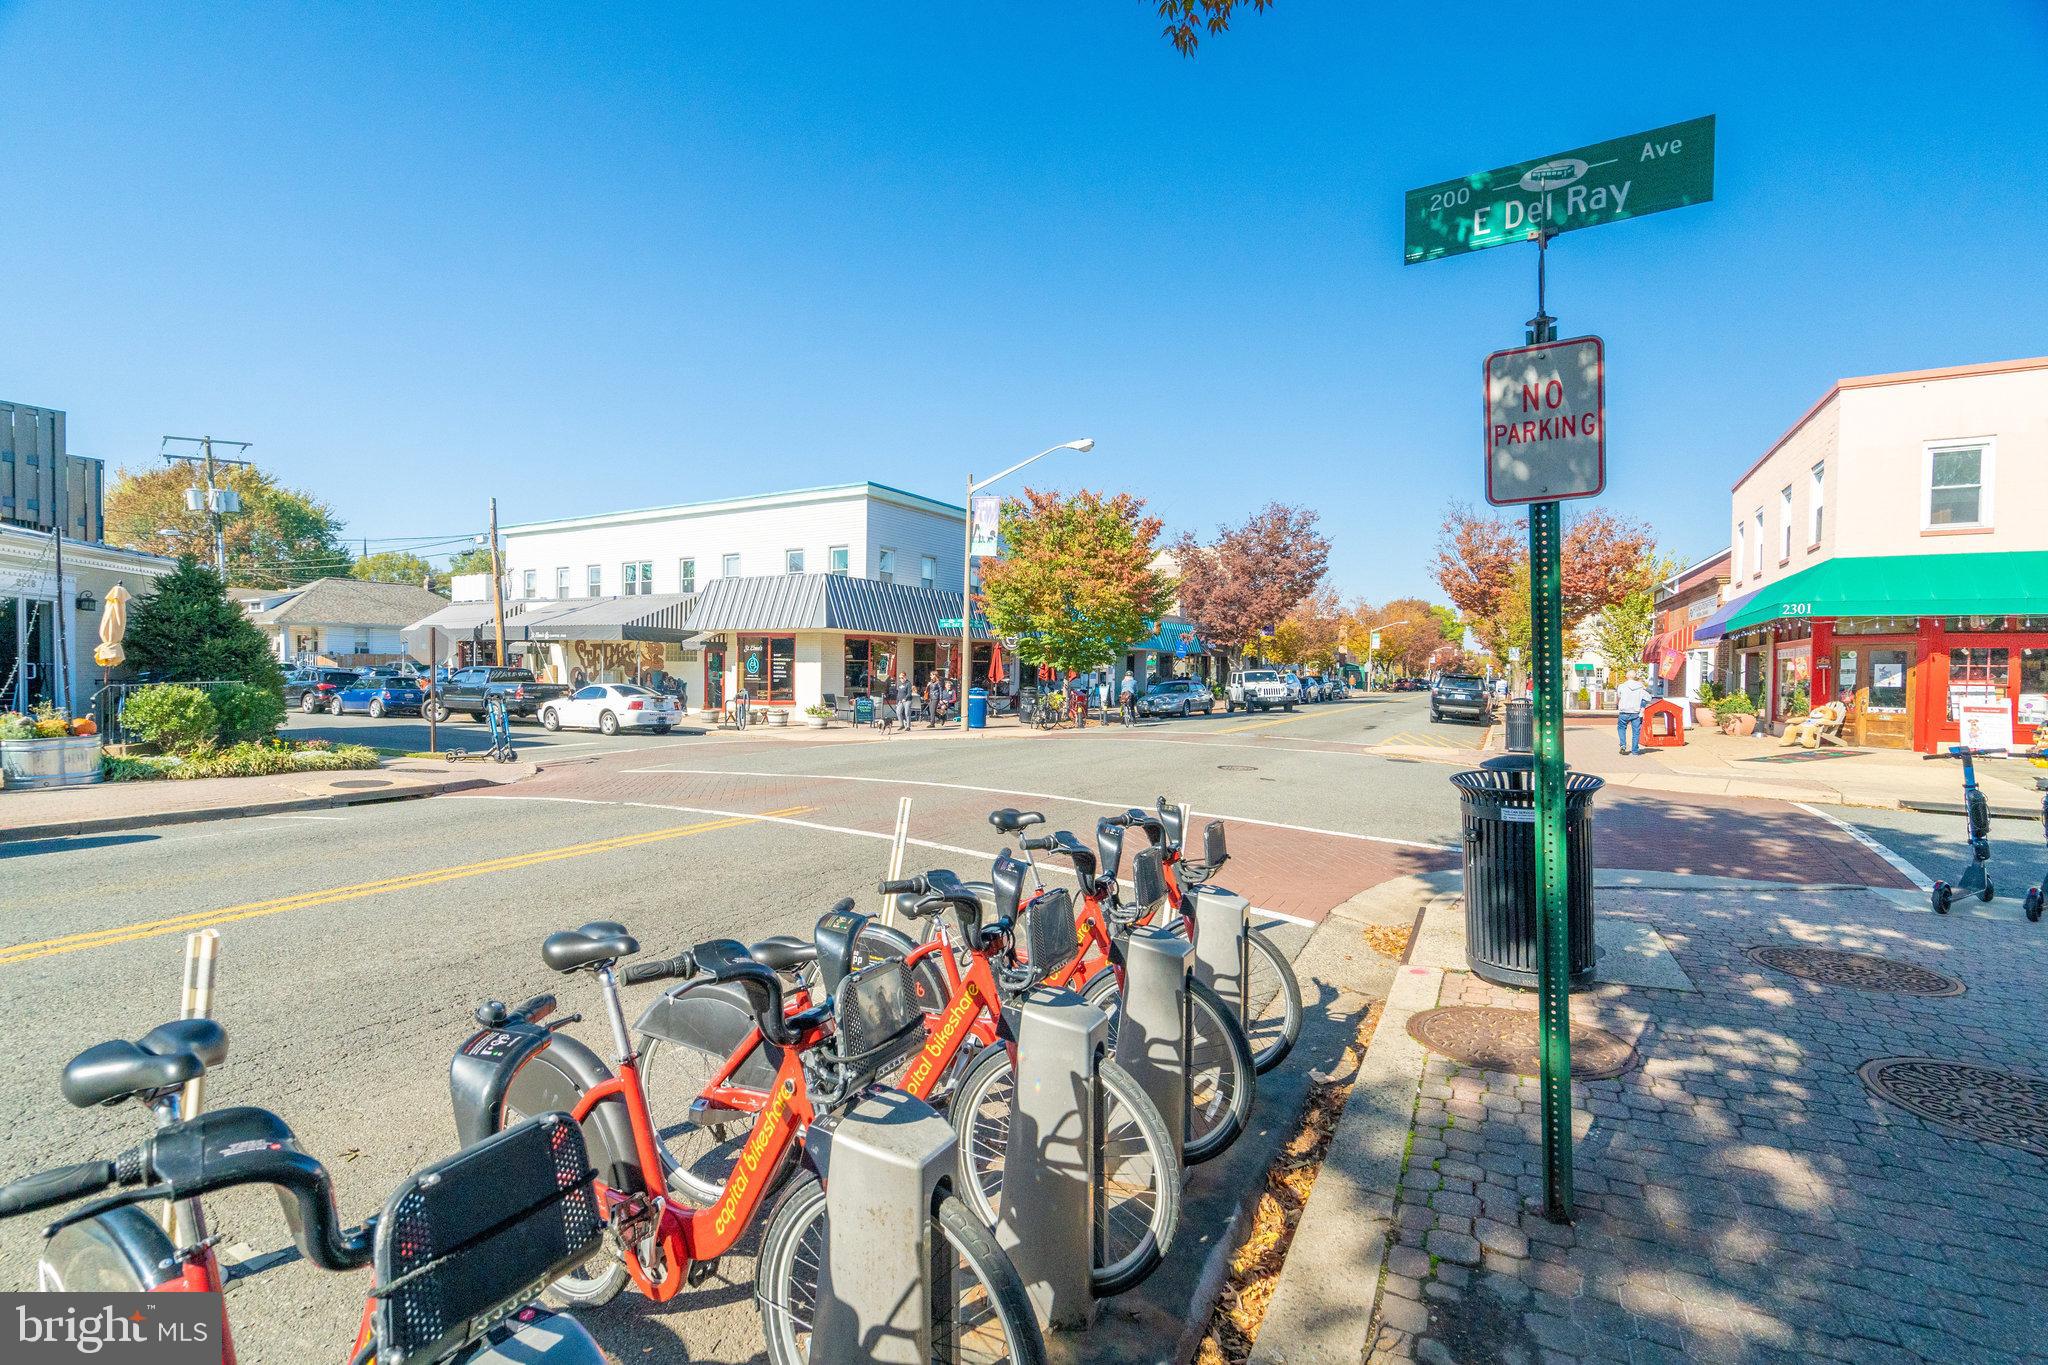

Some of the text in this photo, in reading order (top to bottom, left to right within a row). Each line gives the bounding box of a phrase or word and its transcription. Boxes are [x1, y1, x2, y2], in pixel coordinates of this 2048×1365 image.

[1640, 139, 1683, 163] Ave
[1430, 187, 1470, 212] 200
[1473, 180, 1632, 236] E Del Ray
[1522, 379, 1563, 413] NO
[1494, 412, 1596, 447] PARKING
[1782, 603, 1812, 615] 2301
[907, 983, 979, 1095] pital bikeshare
[715, 1083, 792, 1236] capital bikeshare
